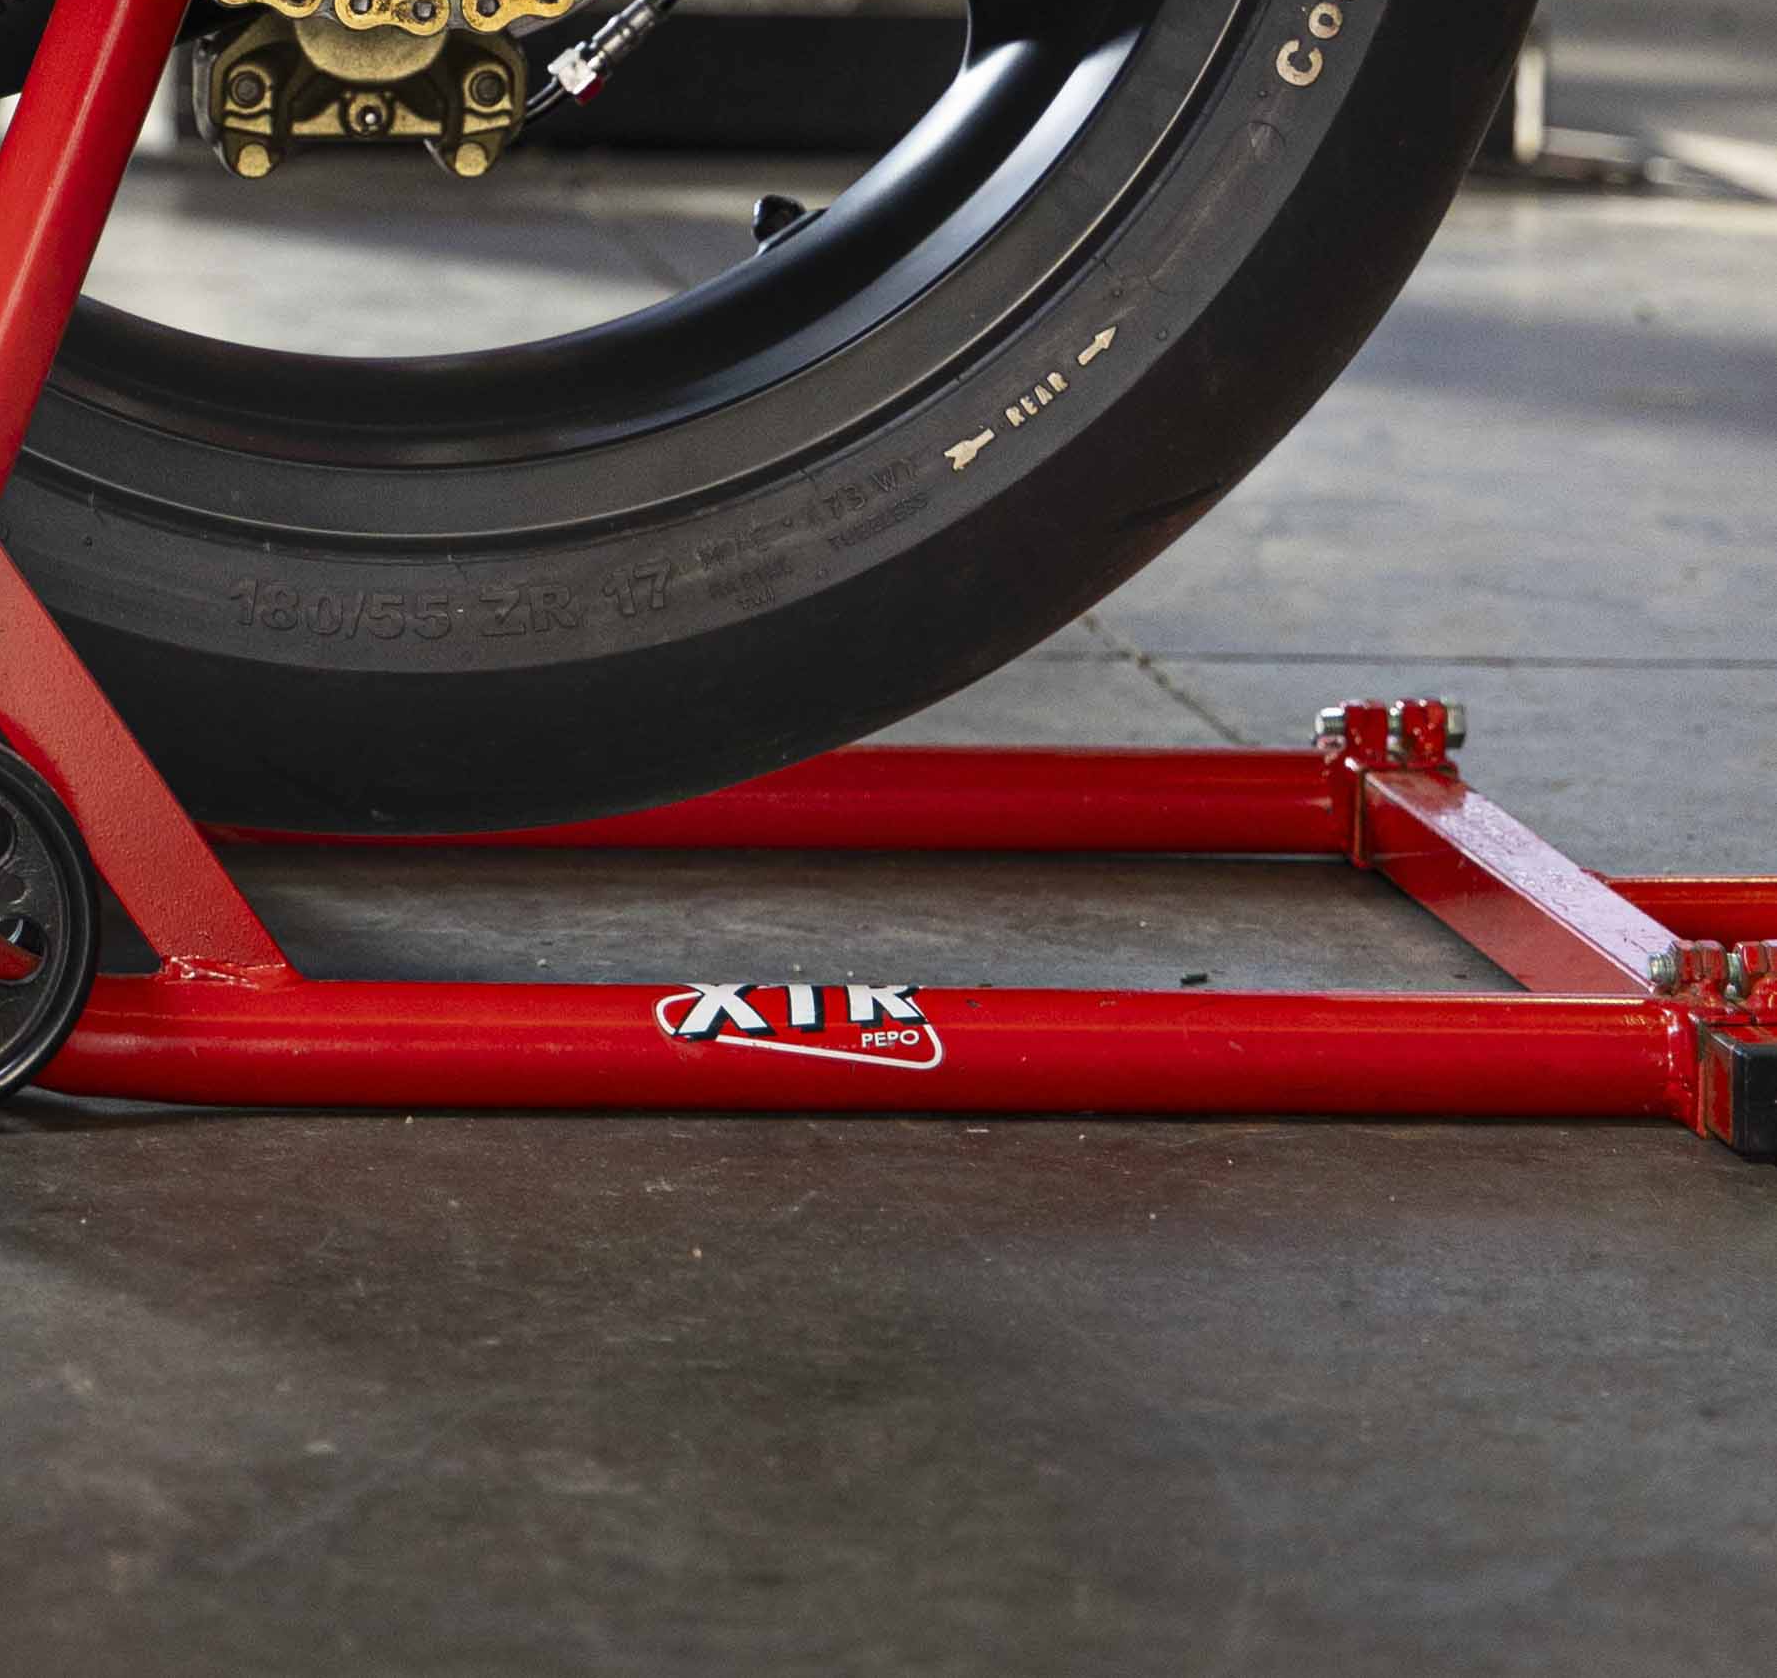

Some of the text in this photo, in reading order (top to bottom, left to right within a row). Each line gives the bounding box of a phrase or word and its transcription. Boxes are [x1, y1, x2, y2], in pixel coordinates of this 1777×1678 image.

[1004, 371, 1070, 428] REAR
[226, 573, 453, 641] 180/55
[479, 576, 583, 640] ZR
[861, 1029, 920, 1049] PEPO
